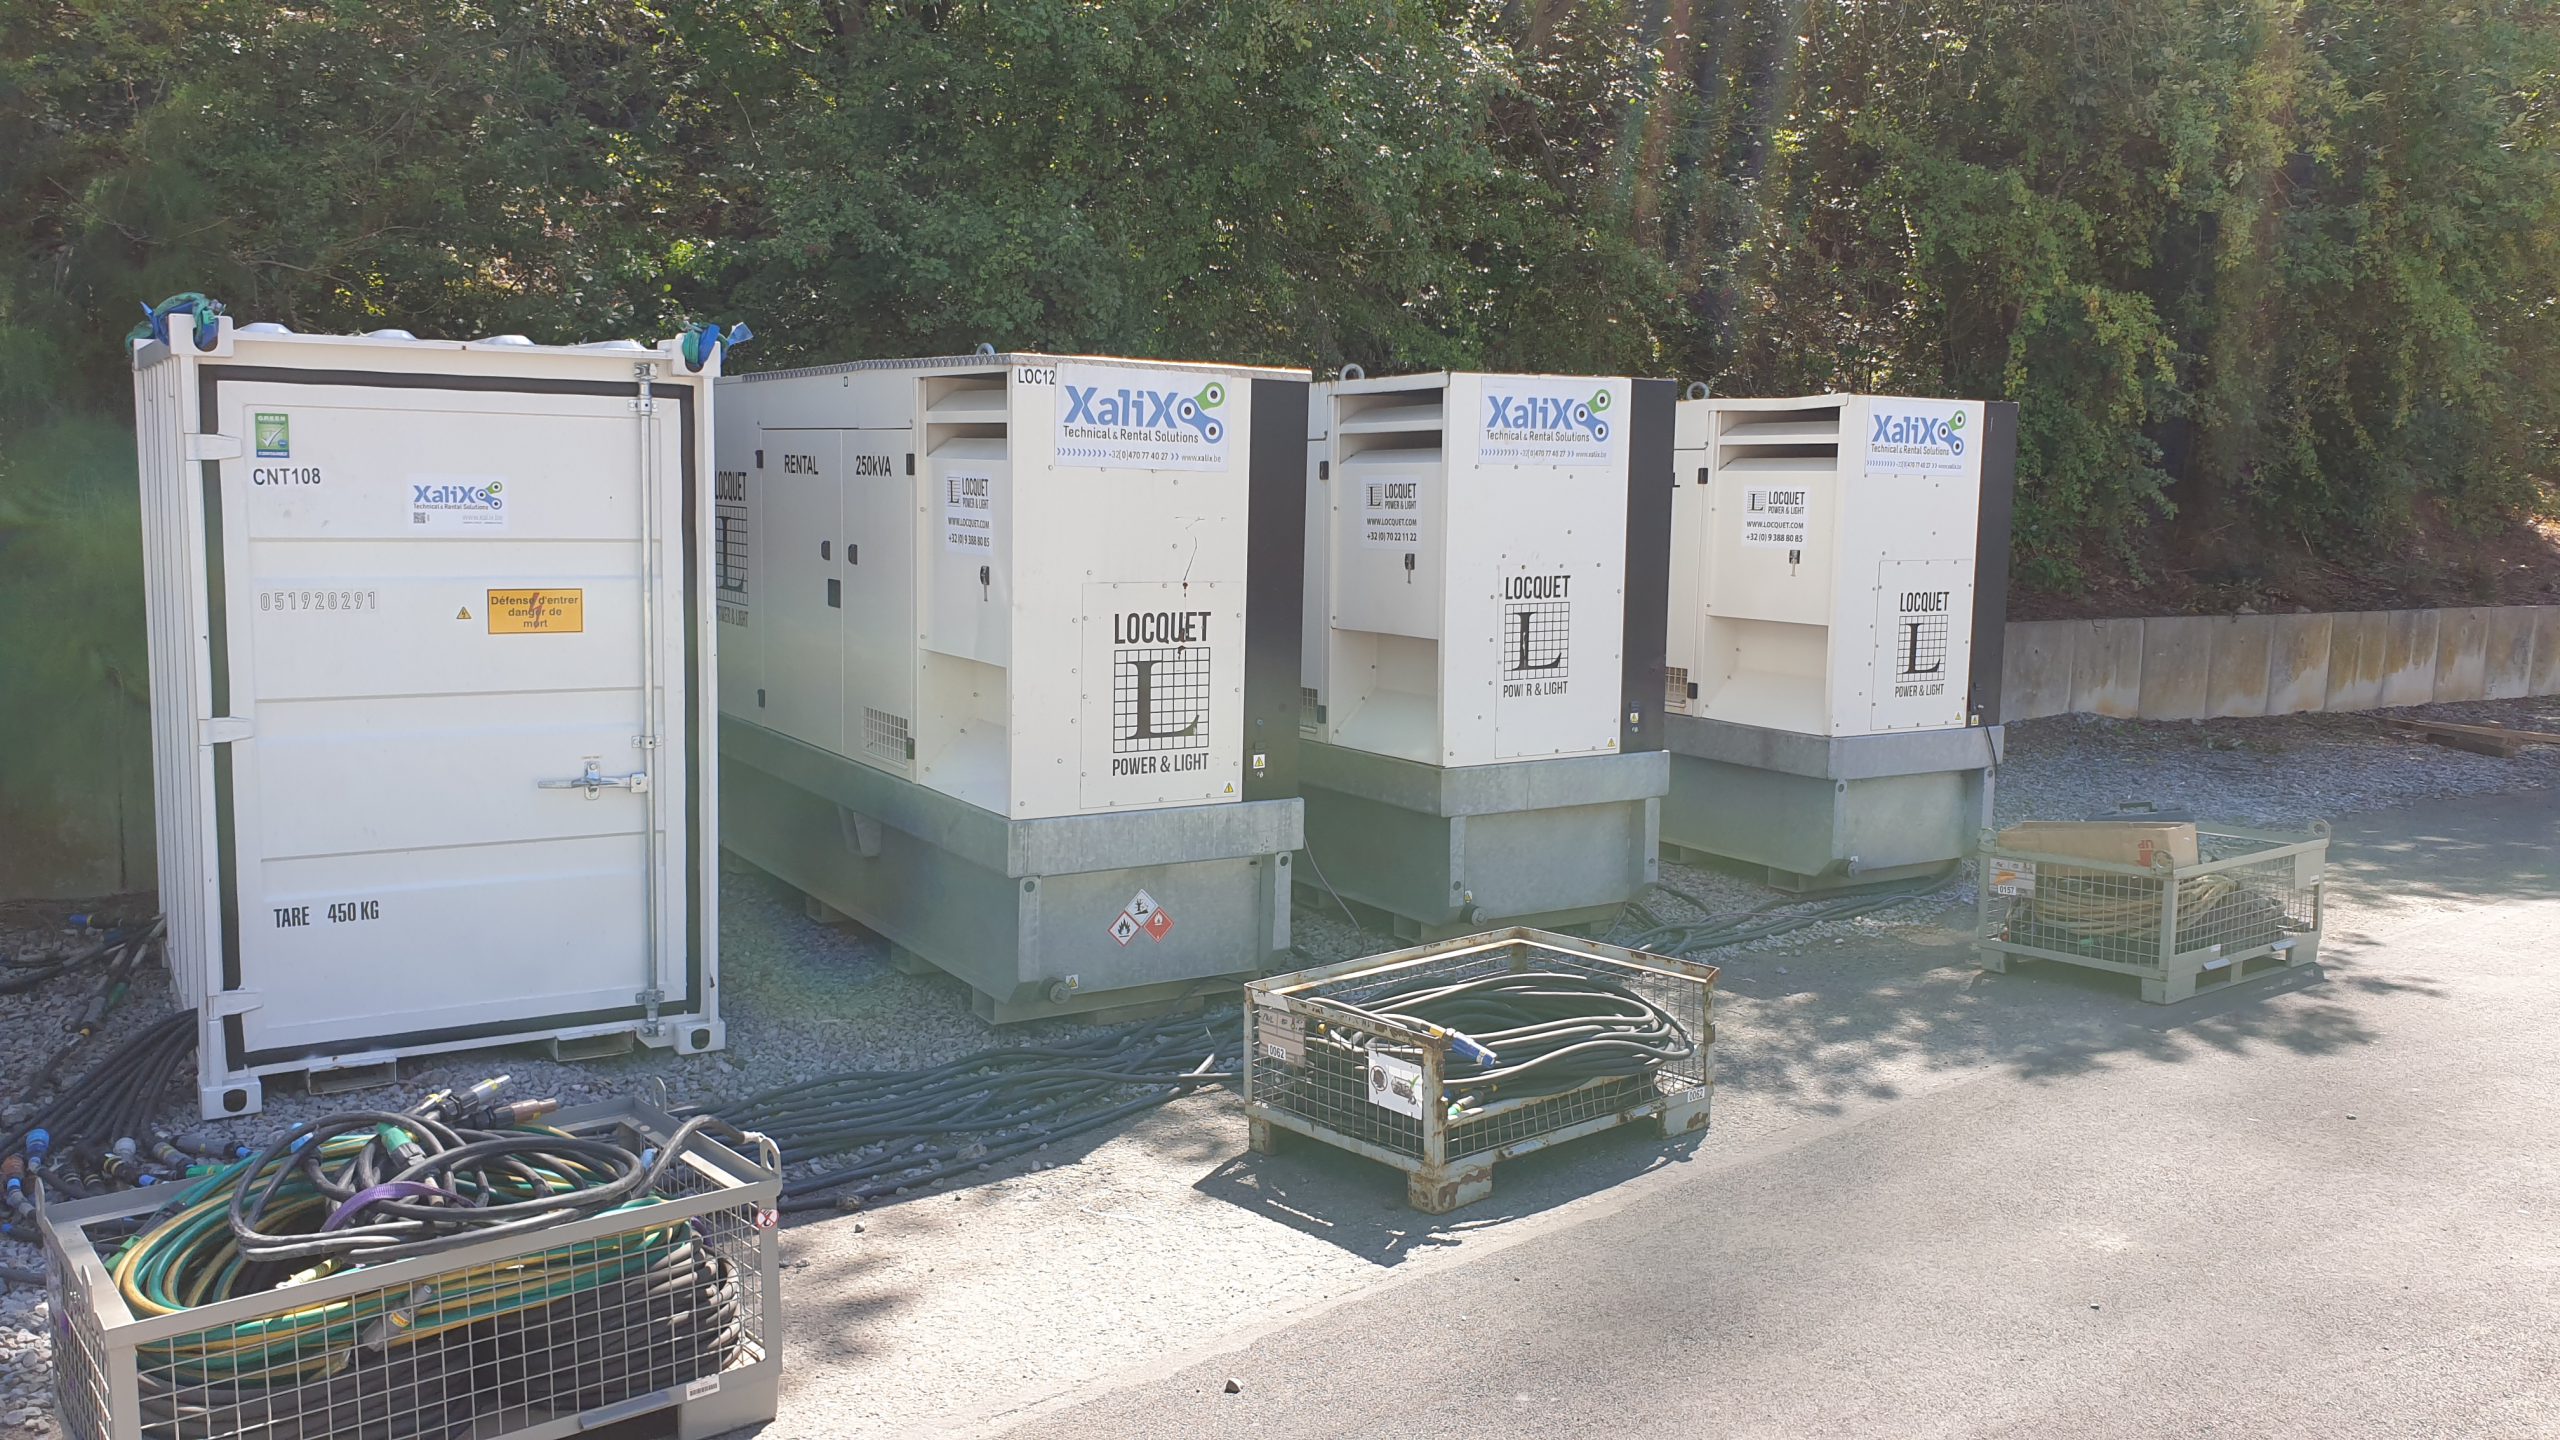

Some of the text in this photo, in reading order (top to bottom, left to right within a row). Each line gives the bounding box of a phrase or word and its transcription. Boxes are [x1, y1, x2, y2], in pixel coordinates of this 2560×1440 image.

[1064, 385, 1178, 429] XaliX
[1486, 396, 1575, 430] XaliX
[1064, 426, 1111, 440] Technical
[1120, 429, 1152, 441] Rental
[1154, 430, 1199, 444] Solutions
[1487, 430, 1522, 440] Technical
[1530, 431, 1553, 441] Rental
[1556, 432, 1589, 442] Solutions
[1872, 414, 1939, 445] XaliX
[1871, 444, 1898, 453] Technical
[1904, 445, 1922, 455] Rental
[1923, 446, 1949, 456] Solutions
[784, 454, 818, 475] RENTAL
[856, 455, 892, 477] 250kVA
[1182, 454, 1221, 463] www.xalix.be
[253, 468, 320, 485] CNT108
[413, 485, 476, 503] XaliX
[962, 478, 988, 497] LOCQUET
[1385, 483, 1416, 499] LOCQUET
[963, 498, 974, 508] POWER
[979, 499, 989, 510] LIGHT
[1385, 501, 1399, 509] POWER
[1405, 501, 1416, 510] LIGHT
[1769, 491, 1805, 505] LOCQUET
[1367, 532, 1377, 540] +32
[1395, 533, 1401, 541] 22
[1410, 533, 1416, 541] 22
[1759, 533, 1767, 541] (0)
[1505, 576, 1570, 600] LOCQUET
[260, 592, 376, 611] 051928291
[491, 596, 578, 605] Défense d'entrer
[1900, 592, 1950, 612] LOCQUET
[508, 608, 562, 618] danger de
[524, 620, 548, 628] mort
[1114, 612, 1211, 644] LOCQUET
[1535, 683, 1541, 696] &
[1544, 681, 1568, 695] LIGHT
[1895, 684, 1944, 698] POWER & LIGHT
[1112, 753, 1209, 776] POWER & LIGHT
[273, 900, 379, 928] TARE 450 KG
[1270, 1045, 1284, 1058] 0062
